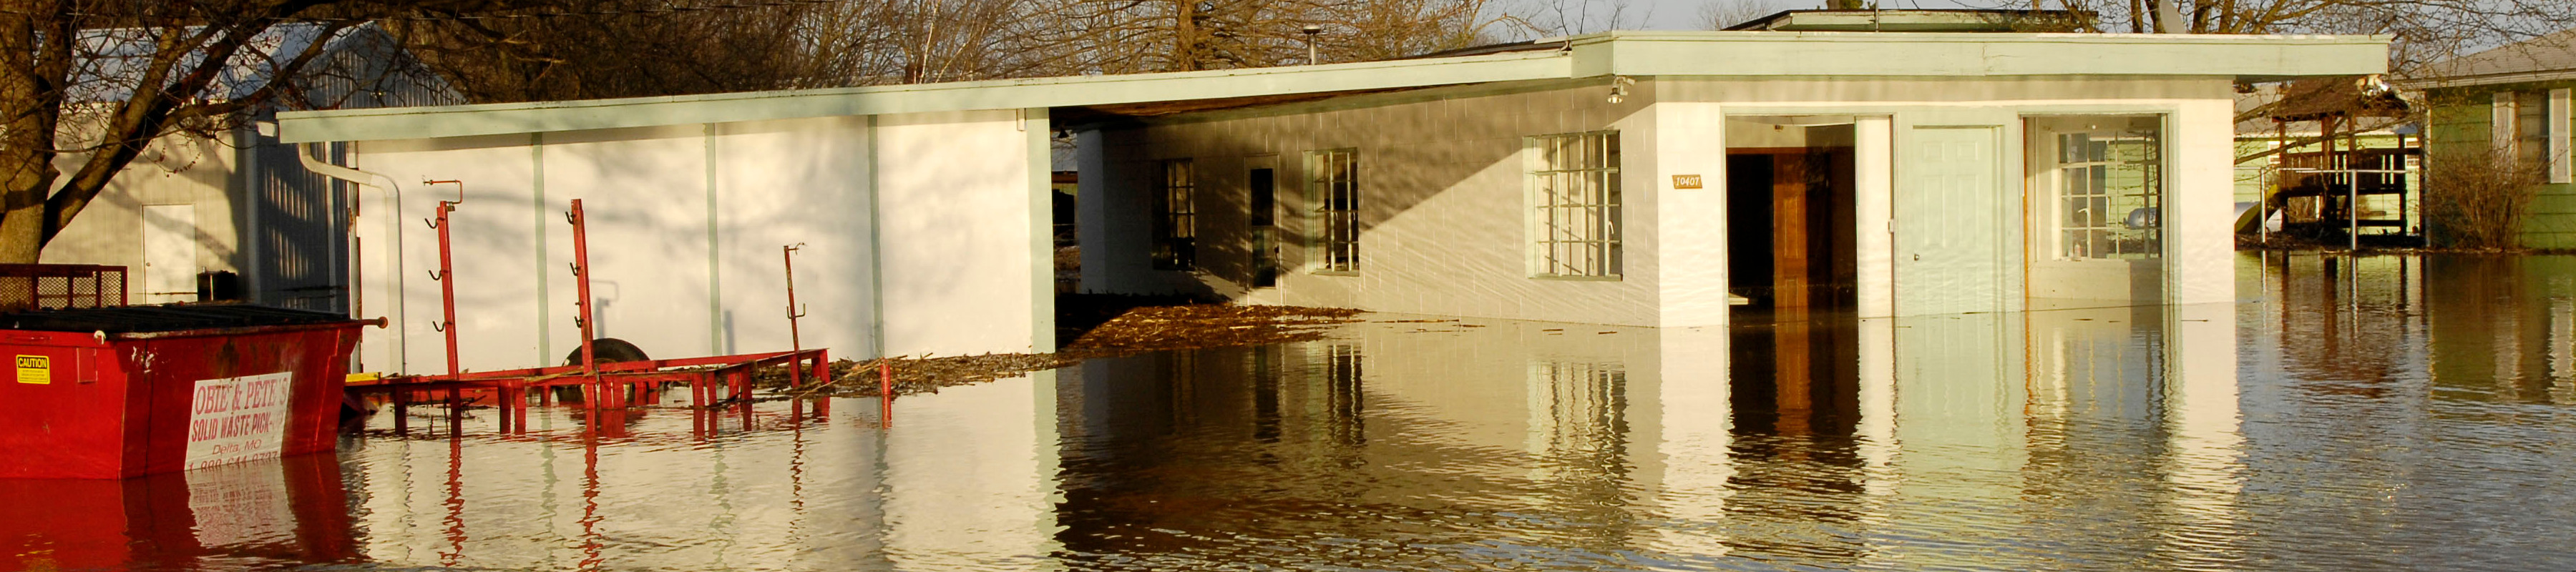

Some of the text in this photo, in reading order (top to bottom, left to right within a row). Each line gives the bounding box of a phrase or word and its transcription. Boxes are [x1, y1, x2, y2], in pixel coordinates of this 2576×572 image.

[1677, 177, 1699, 186] 10407
[19, 358, 47, 368] CAUTION
[195, 384, 229, 415] OBIE
[232, 384, 242, 411] &
[192, 418, 218, 442] SOLID
[220, 413, 250, 438] WASTE
[213, 439, 262, 455] Delta, MO
